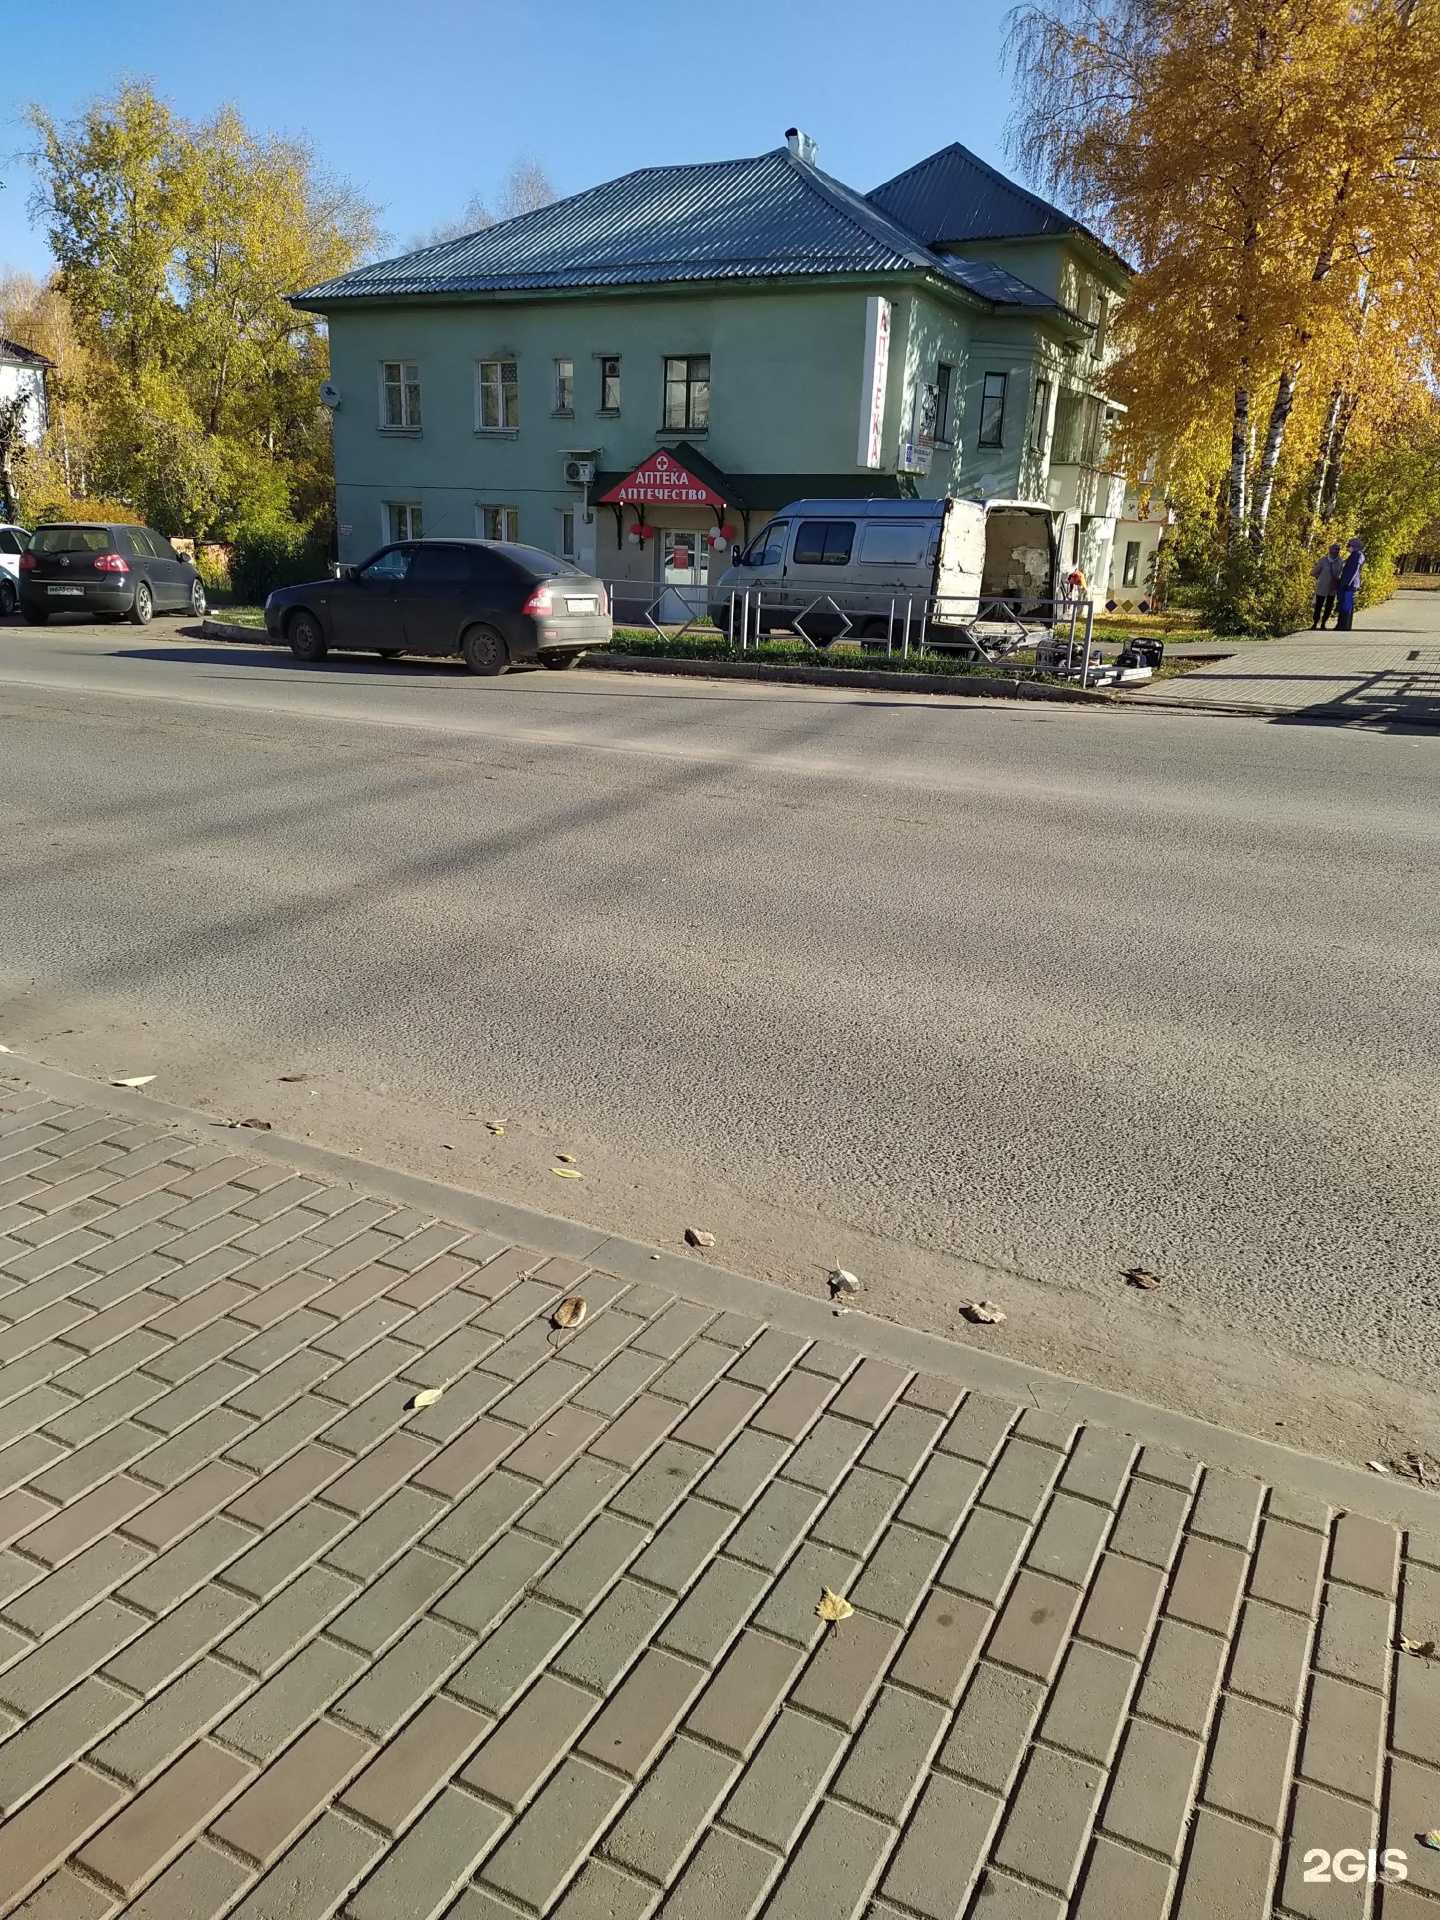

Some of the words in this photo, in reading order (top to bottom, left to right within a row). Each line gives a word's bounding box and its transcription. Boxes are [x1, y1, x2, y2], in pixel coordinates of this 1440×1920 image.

[870, 309, 889, 461] АПТЕКА
[636, 471, 689, 485] АПТЕКА
[619, 488, 707, 500] АПТЕЧЕСТВО
